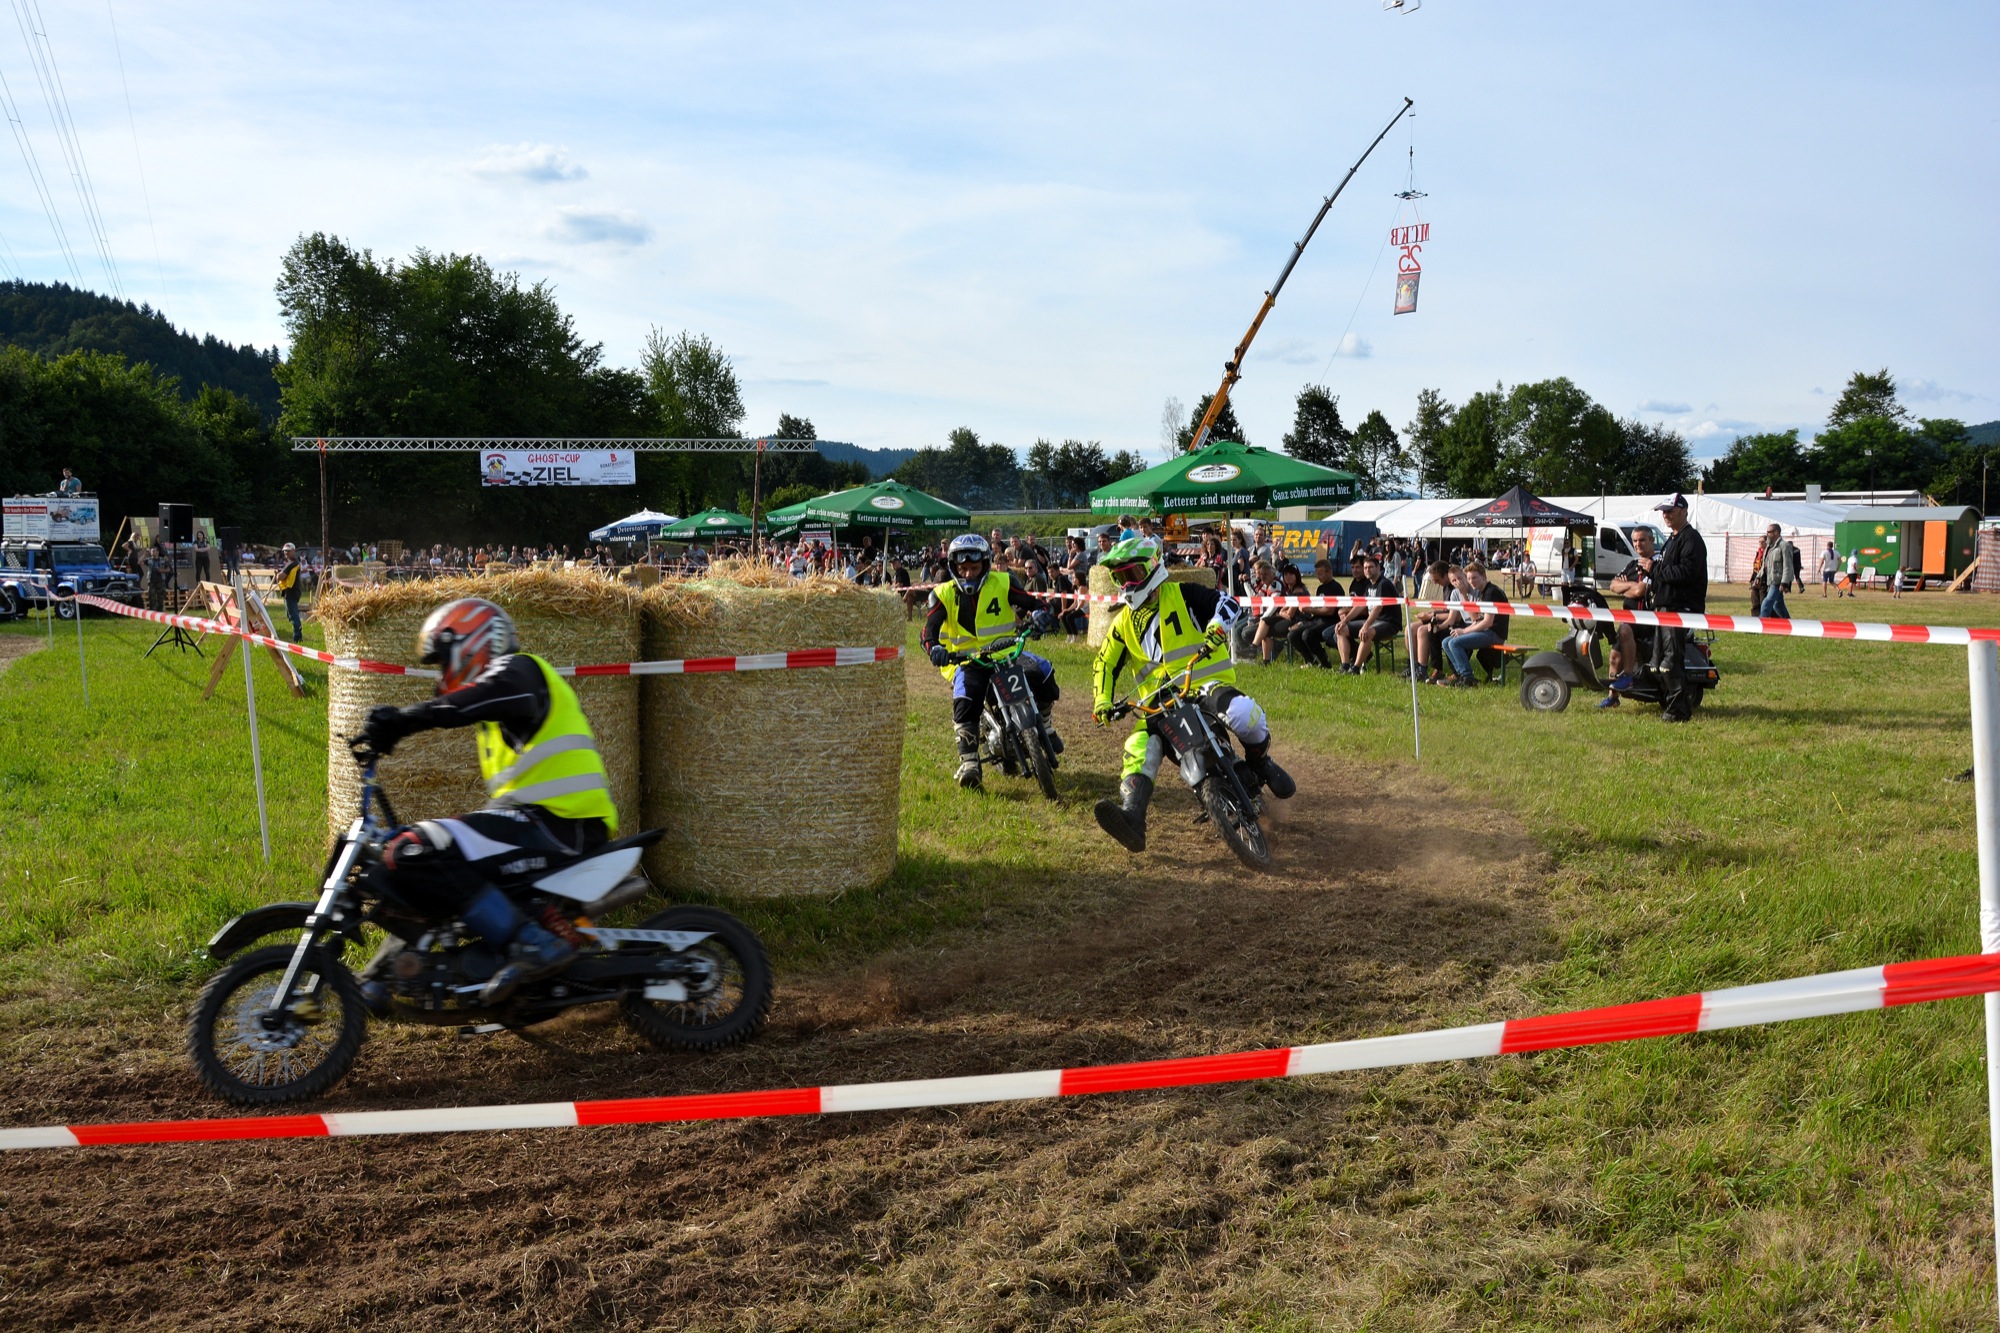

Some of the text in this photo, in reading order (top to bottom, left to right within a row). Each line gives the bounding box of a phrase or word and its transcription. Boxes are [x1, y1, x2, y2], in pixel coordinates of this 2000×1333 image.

[528, 453, 580, 463] GHOST-CUP
[533, 467, 580, 481] ZIEL
[1163, 492, 1257, 508] Ketterer sind netterer.
[1272, 483, 1351, 501] Ganz schön netterer hier.
[857, 514, 878, 523] Ketterer
[880, 515, 891, 523] sind
[616, 525, 648, 534] Peterstaler
[986, 598, 1001, 616] 4
[1164, 610, 1183, 637] 1
[1008, 675, 1023, 693] 2
[1179, 717, 1193, 736] 1
